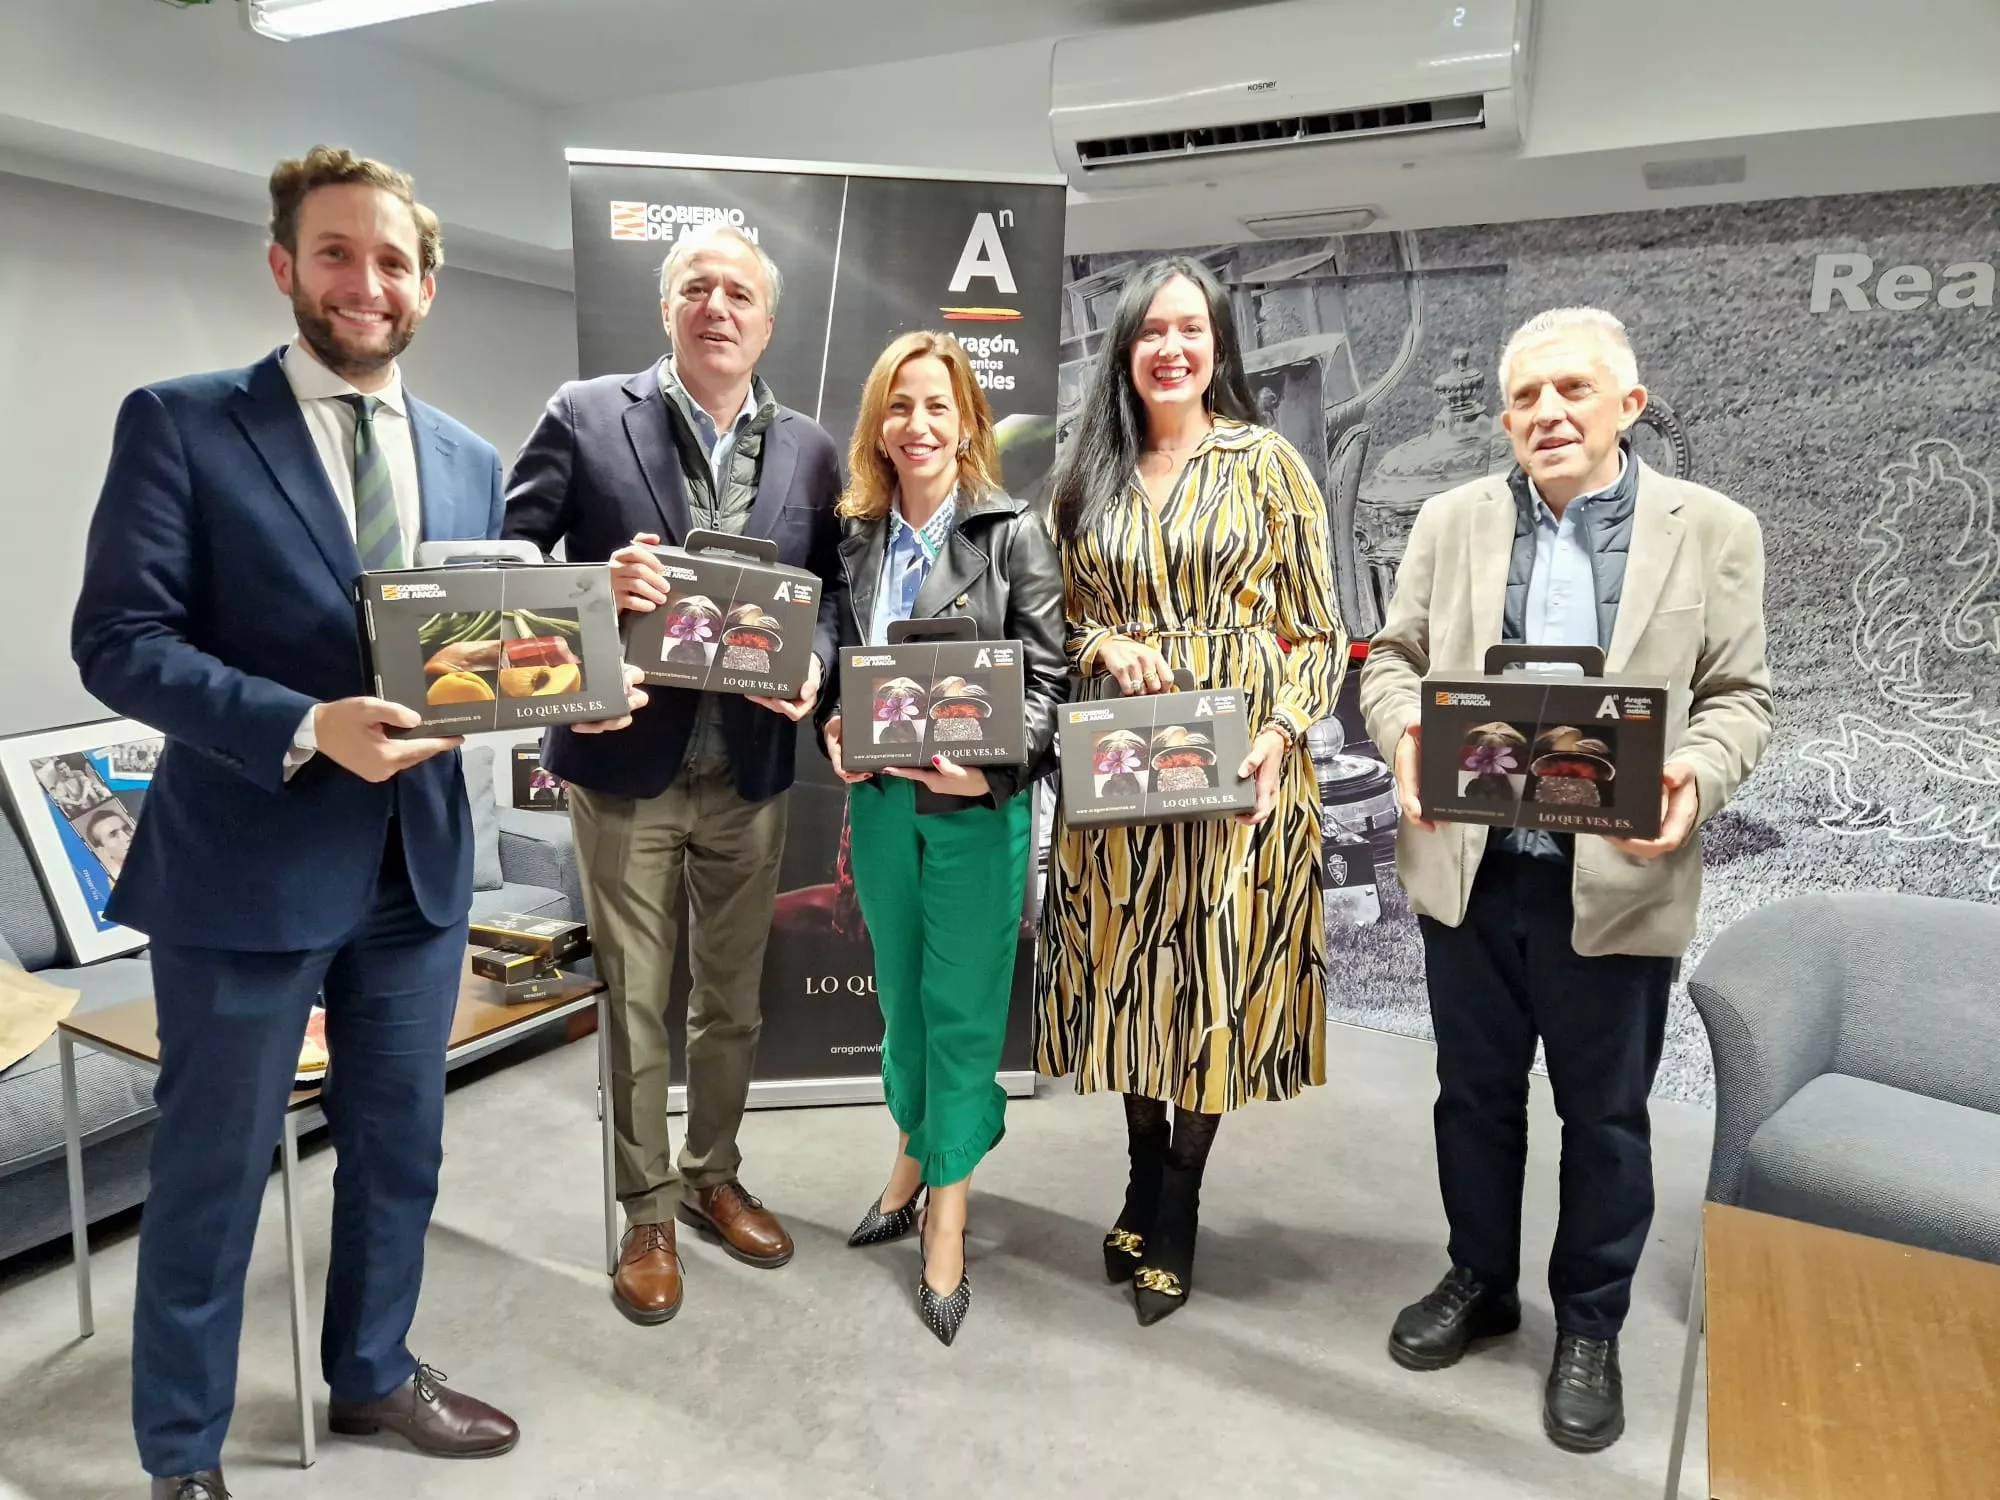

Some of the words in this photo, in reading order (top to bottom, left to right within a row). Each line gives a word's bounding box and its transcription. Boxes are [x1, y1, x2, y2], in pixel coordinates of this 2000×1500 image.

[648, 204, 745, 226] GOBIERNO
[648, 223, 674, 241] DE
[1809, 253, 1996, 313] Rea
[948, 332, 1020, 358] ragón,
[970, 358, 1004, 370] entos
[975, 370, 1016, 390] bles
[723, 677, 736, 686] LO
[738, 679, 756, 689] QUE
[517, 706, 533, 718] LO
[536, 704, 560, 717] QUE
[1539, 813, 1556, 824] LO
[1558, 814, 1583, 826] QUE
[806, 976, 839, 994] LO
[847, 975, 878, 996] QU
